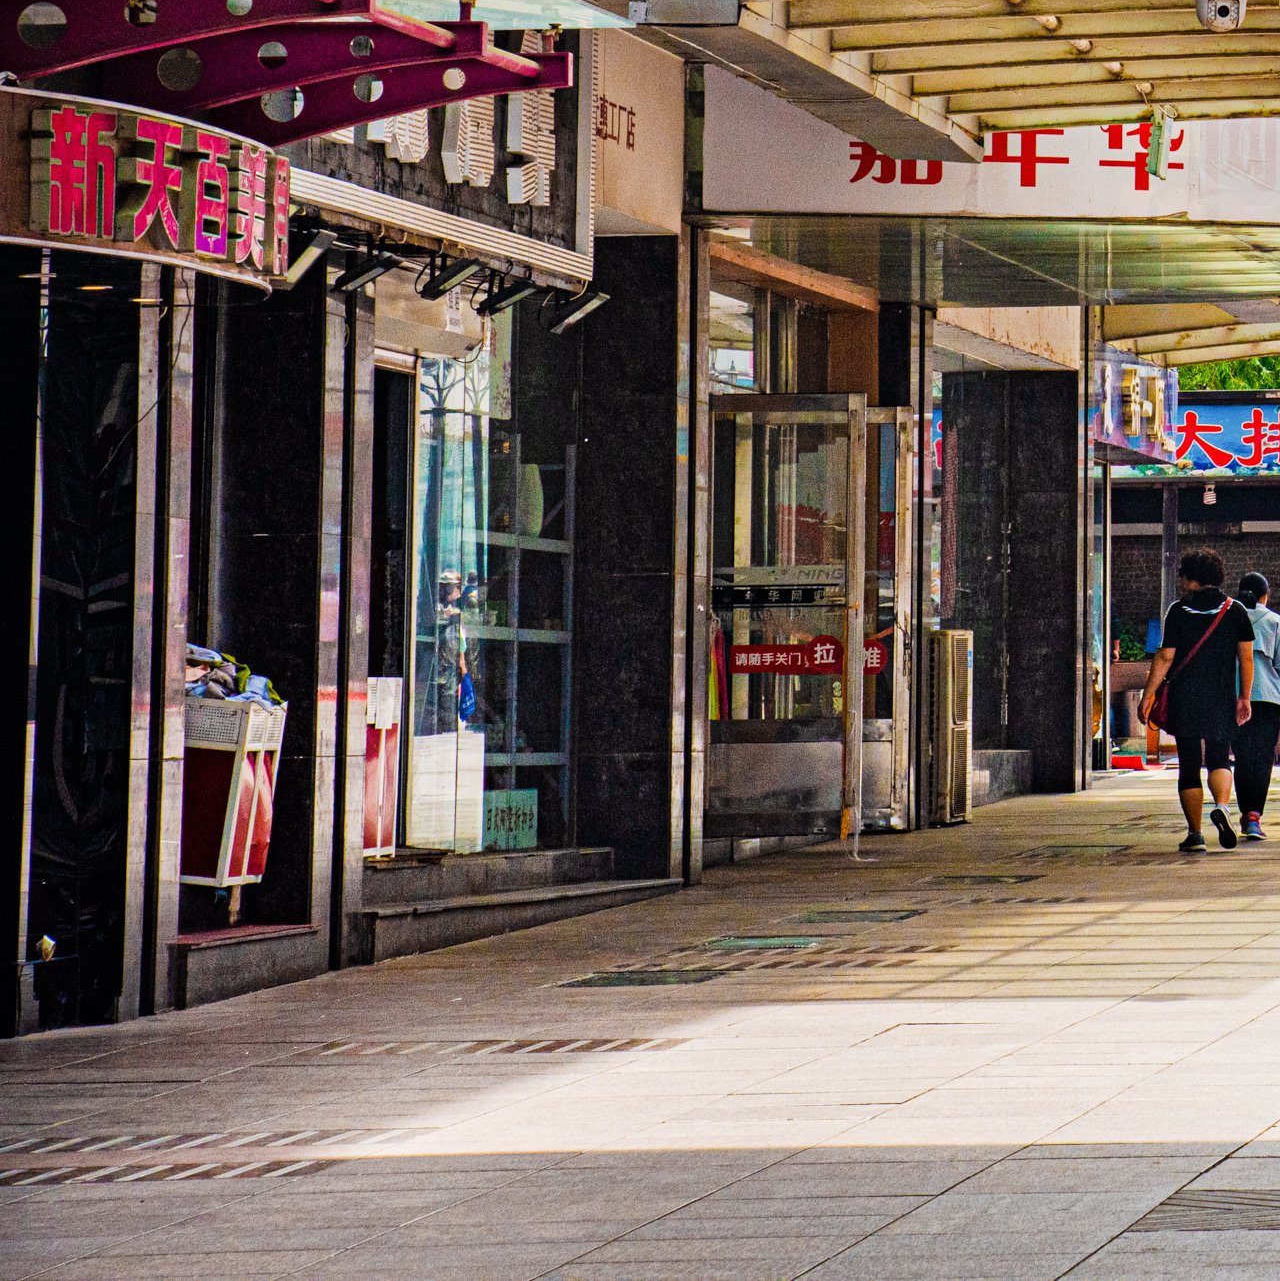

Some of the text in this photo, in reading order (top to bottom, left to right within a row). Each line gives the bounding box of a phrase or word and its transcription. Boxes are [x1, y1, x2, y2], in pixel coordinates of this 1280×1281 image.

[735, 652, 801, 667] 请随手关门
[814, 643, 835, 664] 拉
[863, 646, 881, 668] 推
